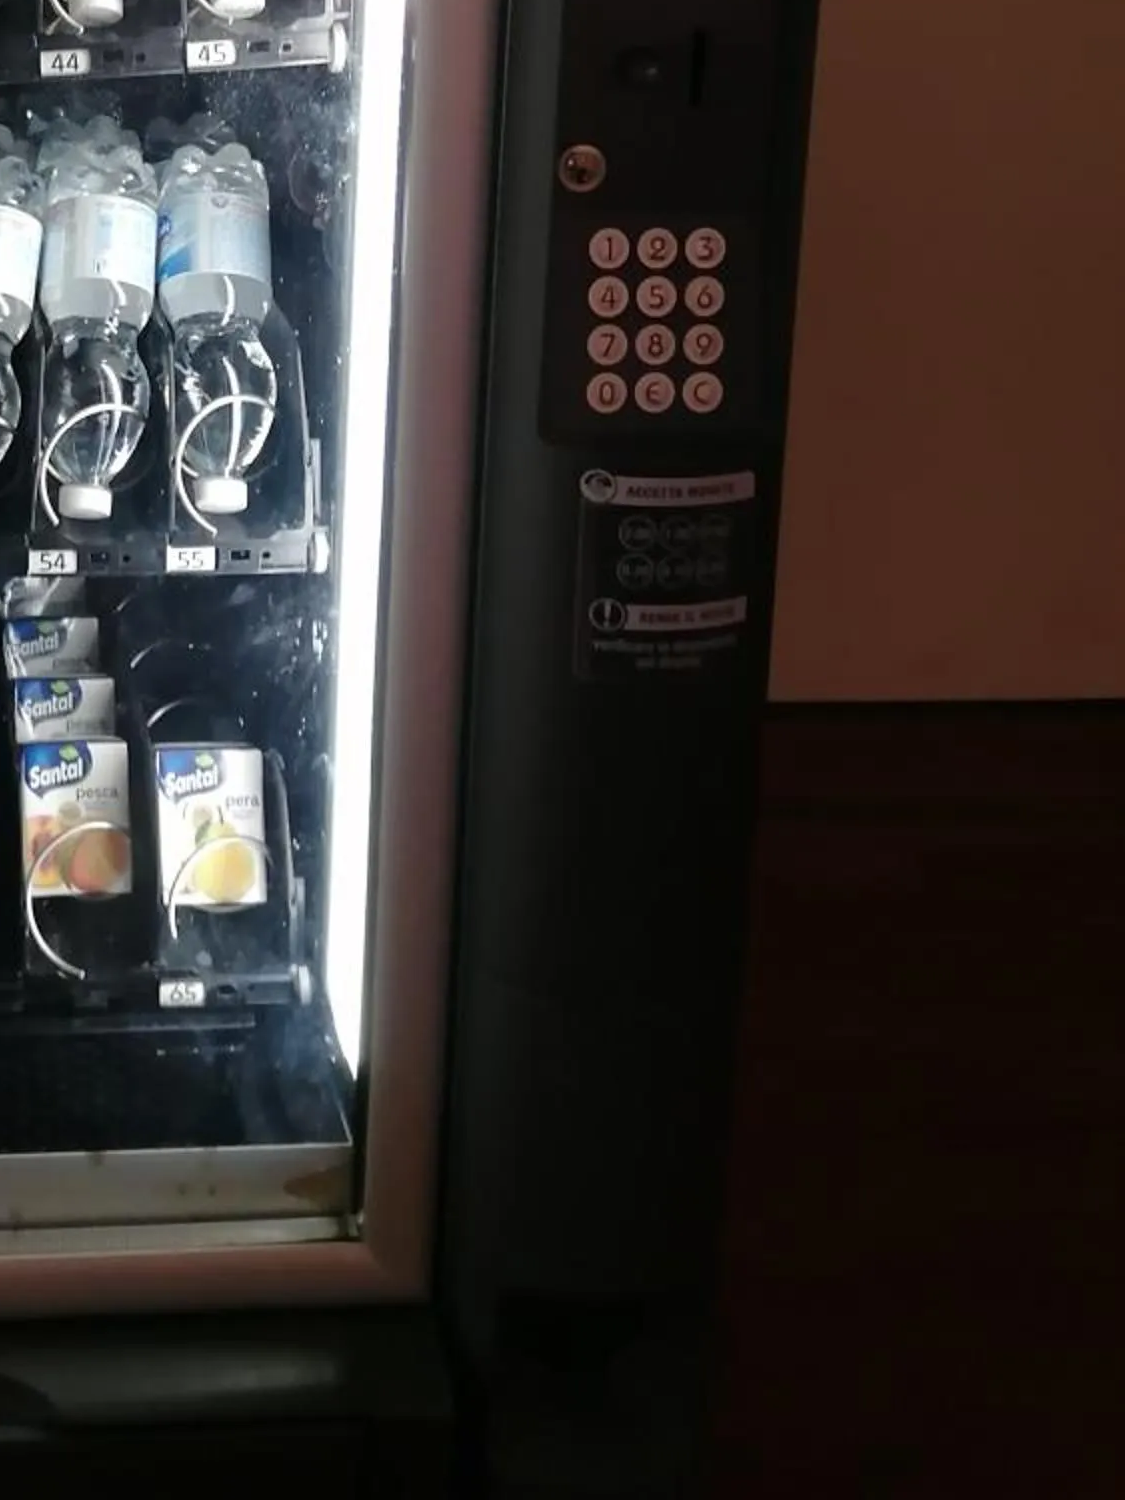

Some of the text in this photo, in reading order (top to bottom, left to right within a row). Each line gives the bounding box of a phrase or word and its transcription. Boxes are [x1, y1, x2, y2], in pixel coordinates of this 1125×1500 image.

[50, 52, 78, 73] 44
[198, 42, 226, 63] 45
[649, 236, 666, 260] 2
[697, 236, 714, 261] 3
[600, 285, 713, 309] 4 5 6
[600, 332, 712, 358] 7 8 9
[598, 380, 615, 405] 0
[693, 380, 710, 405] C
[40, 553, 66, 572] 54
[178, 551, 204, 569] 55
[23, 690, 74, 718] Santal
[29, 757, 84, 790] Santal
[164, 764, 220, 800] Santal
[75, 784, 120, 802] pesca
[225, 792, 261, 810] pera
[170, 982, 196, 1003] 65
